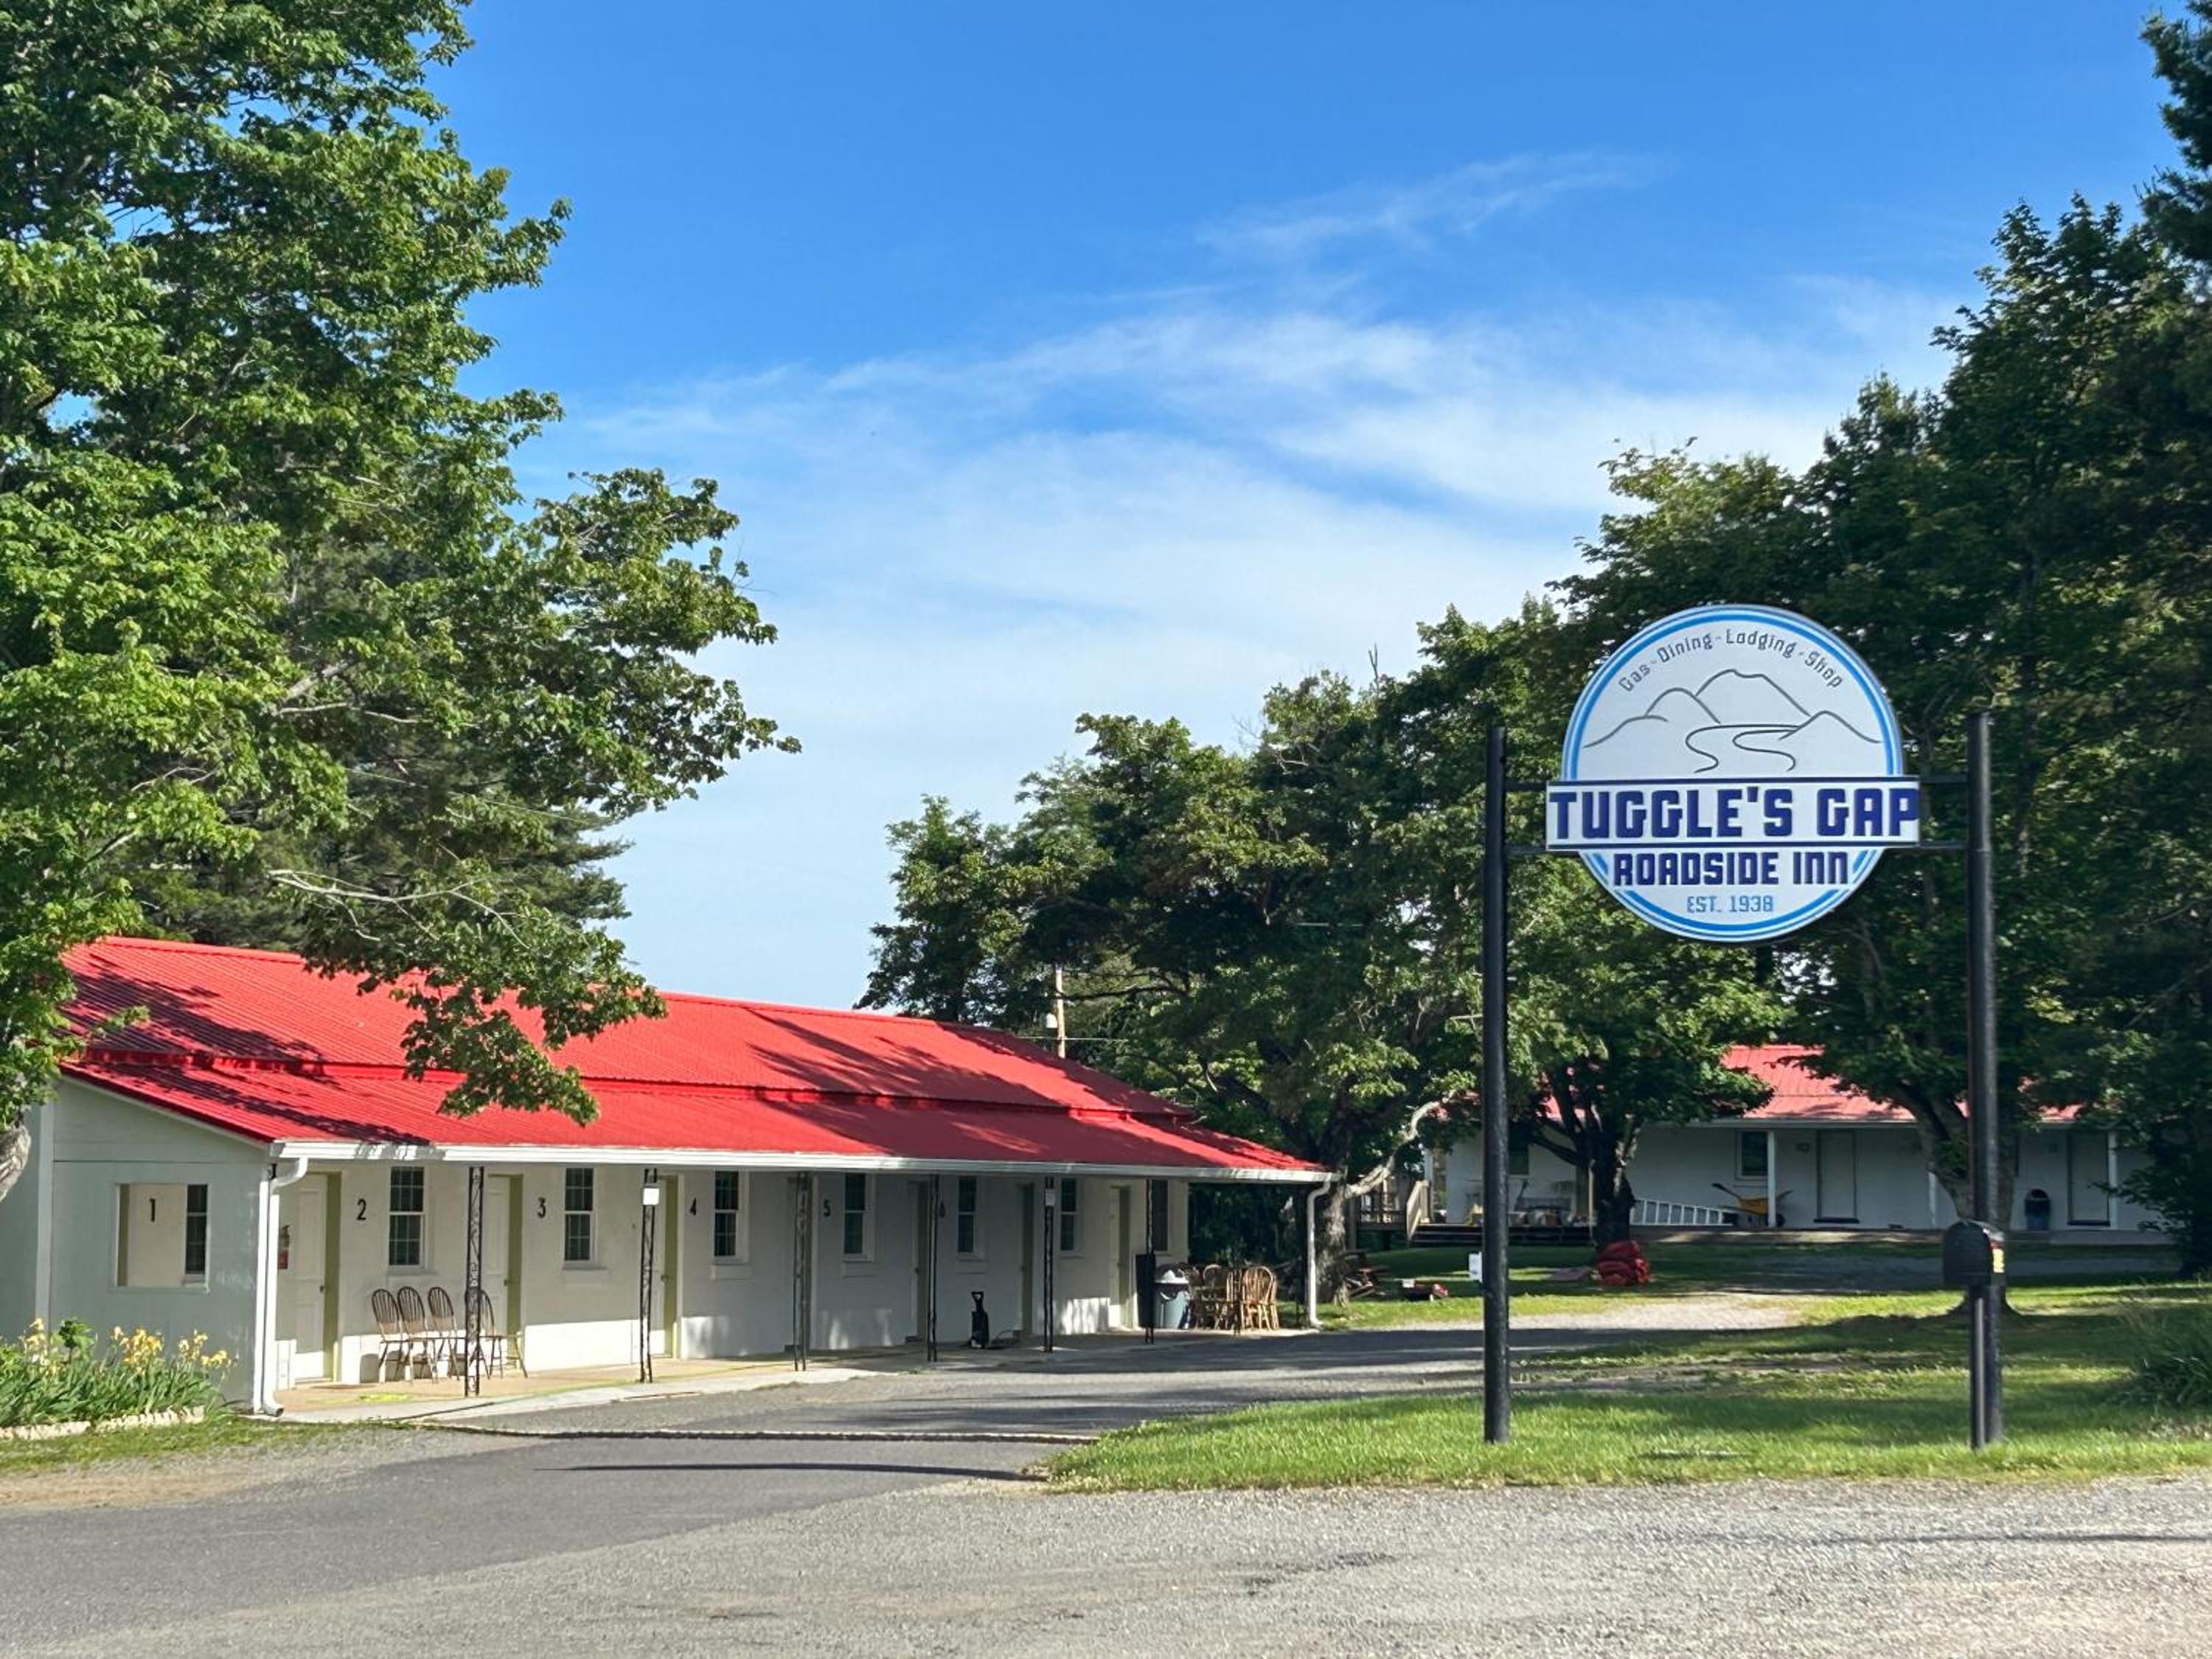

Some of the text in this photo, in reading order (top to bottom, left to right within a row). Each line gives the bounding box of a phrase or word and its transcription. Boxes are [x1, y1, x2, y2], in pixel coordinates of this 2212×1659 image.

[1618, 629, 1843, 692] Gas Dining Lodging Shop
[1548, 786, 1919, 840] TUGGLE'S GAP
[1613, 852, 1779, 886] ROADSIDE
[1686, 895, 1774, 913] EST. 1938
[149, 1198, 156, 1221] 1
[356, 1198, 366, 1220] 2
[537, 1197, 547, 1219] 3
[689, 1197, 697, 1216] 4
[824, 1199, 831, 1217] 5
